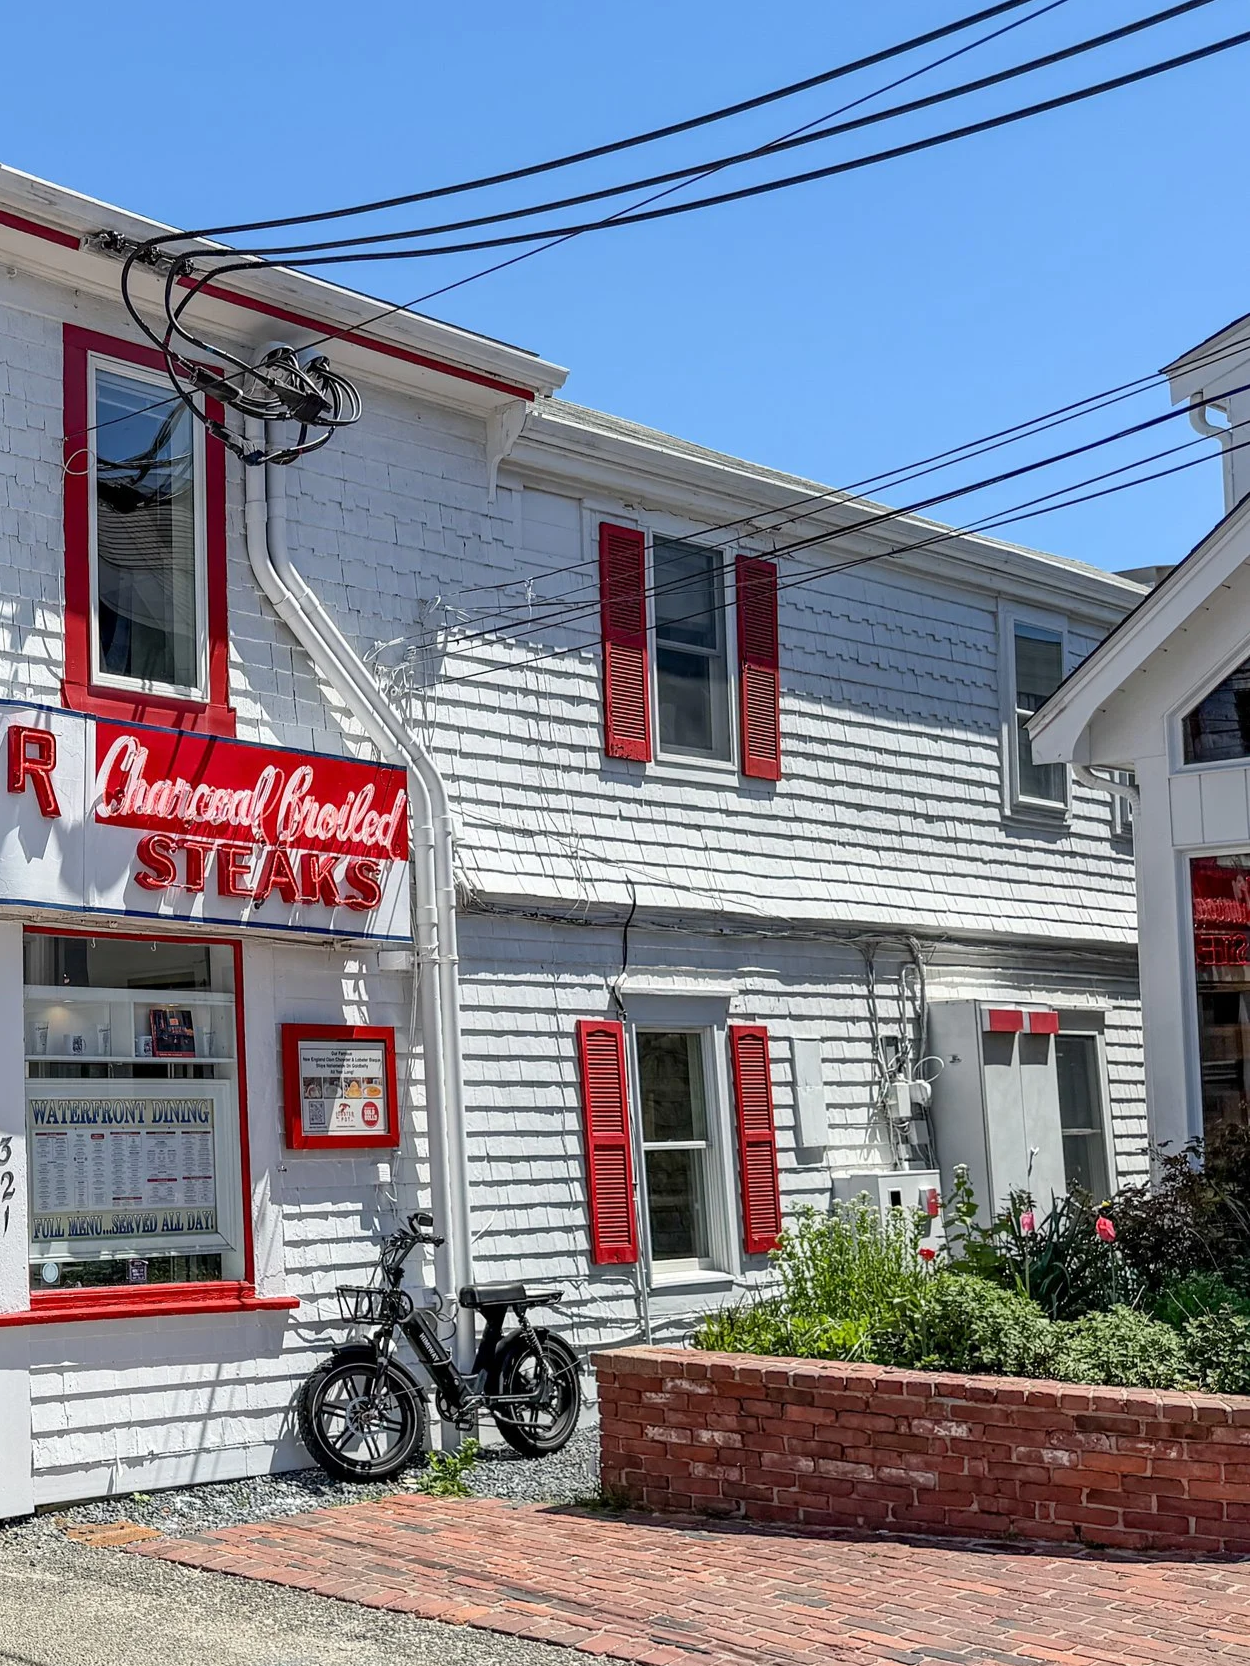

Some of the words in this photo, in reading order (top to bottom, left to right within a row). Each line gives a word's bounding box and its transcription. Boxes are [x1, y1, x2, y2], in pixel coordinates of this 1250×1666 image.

[95, 735, 282, 842] Charcoal
[277, 765, 406, 858] Broiled
[134, 834, 382, 911] STEAKS
[31, 1100, 147, 1125] WATERFRONT
[151, 1099, 210, 1124] DINING
[33, 1216, 65, 1239] FULL
[161, 1211, 184, 1232] ALL
[187, 1210, 215, 1230] DAY!
[419, 1332, 440, 1362] HIMIWAY
